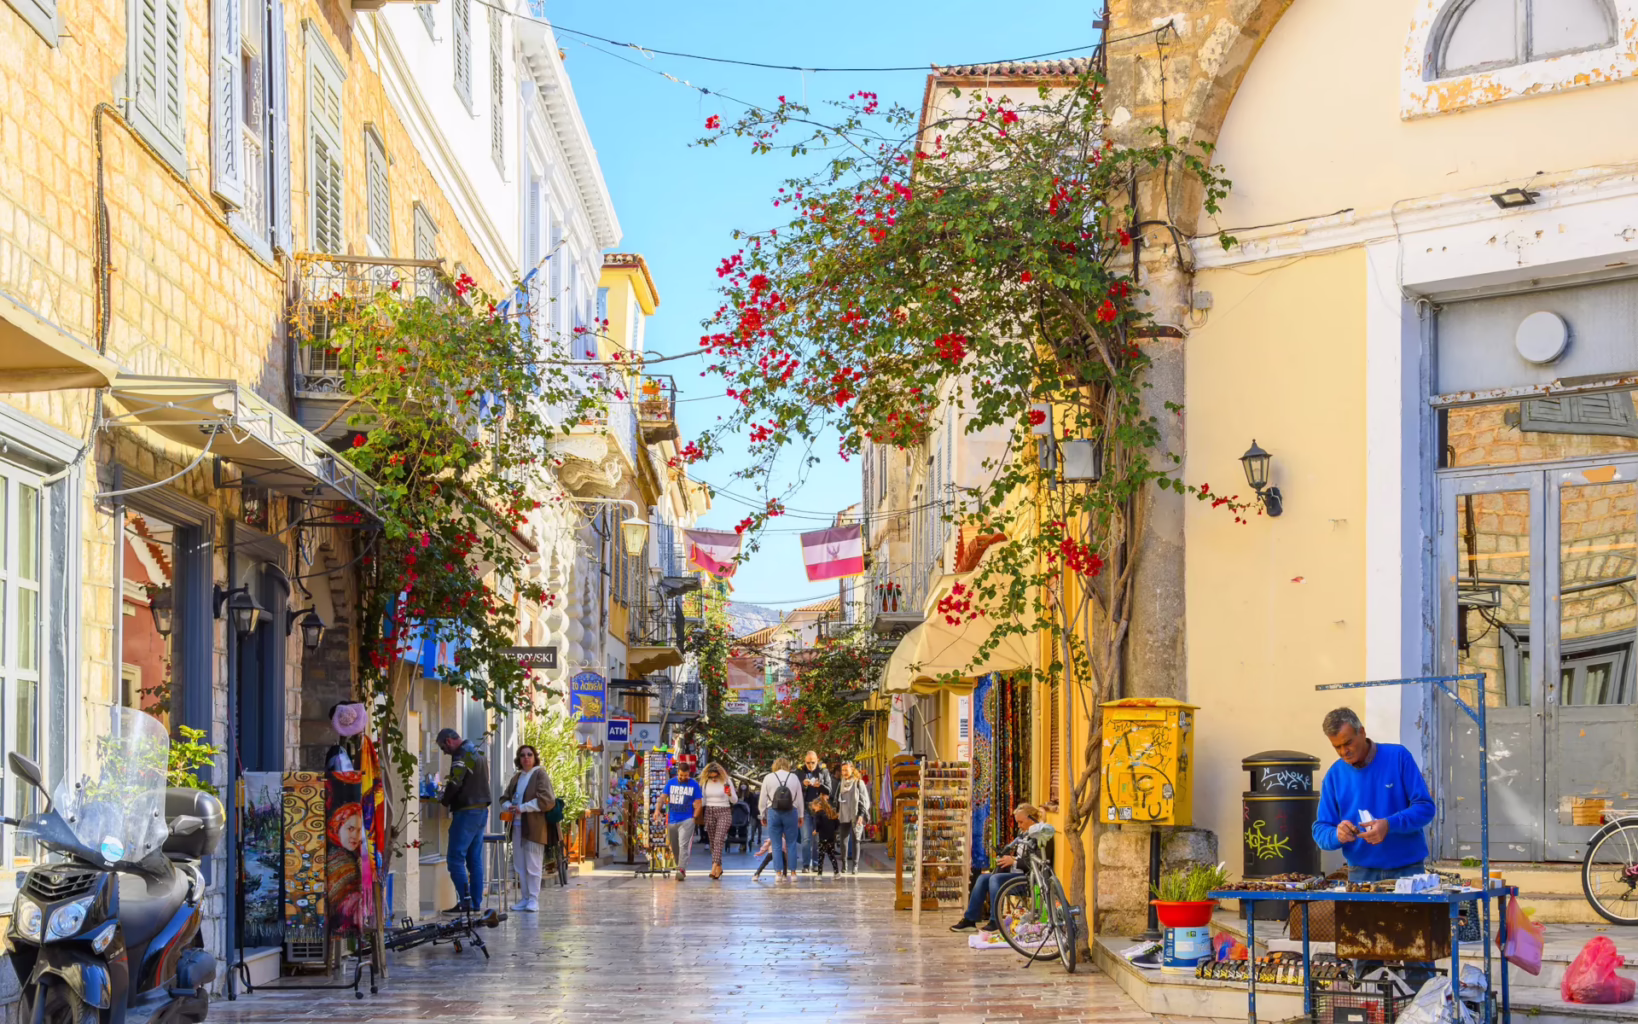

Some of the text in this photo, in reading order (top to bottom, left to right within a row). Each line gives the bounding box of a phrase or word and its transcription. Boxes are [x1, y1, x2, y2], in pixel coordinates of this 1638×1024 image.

[609, 727, 627, 735] ATM
[669, 785, 694, 796] URBAN
[669, 795, 684, 805] MEN
